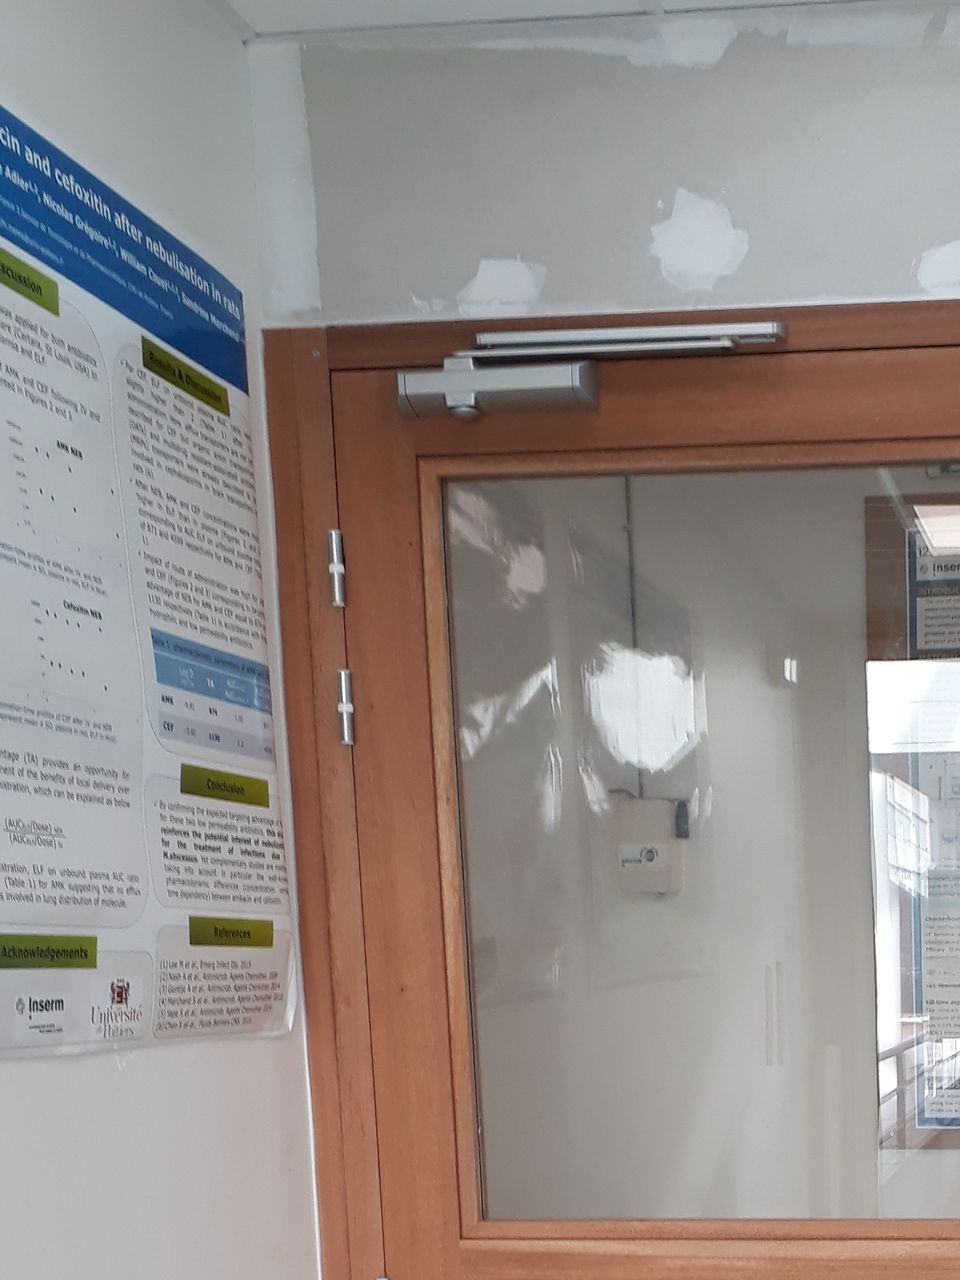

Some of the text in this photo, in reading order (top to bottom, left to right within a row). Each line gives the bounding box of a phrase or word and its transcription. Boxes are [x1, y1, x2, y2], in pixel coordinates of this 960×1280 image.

[24, 144, 51, 178] and
[55, 168, 111, 222] cefoxitin
[113, 211, 142, 243] after
[145, 234, 210, 295] nebulisation
[211, 282, 222, 300] in
[223, 296, 241, 320] rats
[206, 778, 245, 795] Conclusion
[213, 925, 252, 939] References
[1, 946, 89, 961] Acknowledgements
